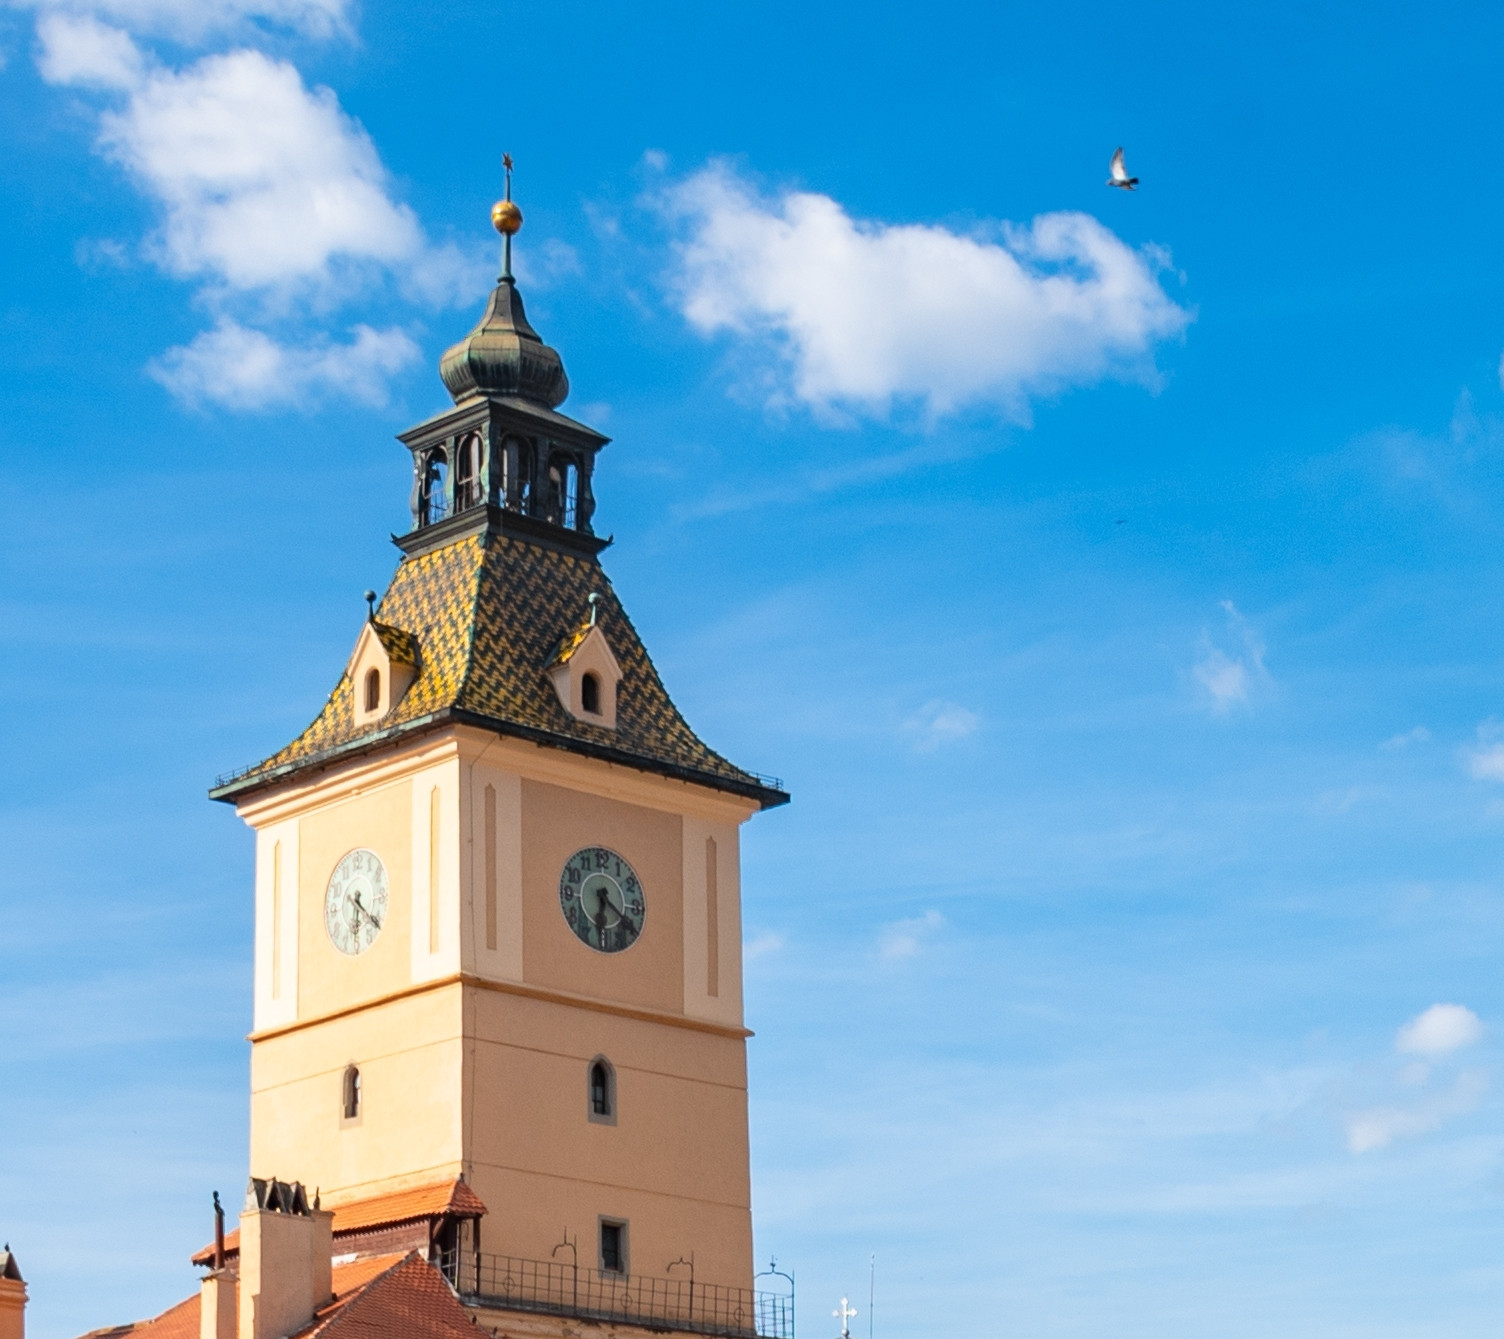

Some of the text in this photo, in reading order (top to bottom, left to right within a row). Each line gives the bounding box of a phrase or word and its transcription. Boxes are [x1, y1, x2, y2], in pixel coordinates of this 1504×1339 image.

[581, 855, 591, 871] 11
[595, 851, 609, 869] 12
[565, 865, 581, 884] 10
[615, 862, 621, 877] 1
[563, 885, 574, 901] 9
[626, 876, 635, 894] 2
[569, 906, 577, 924] 8
[630, 898, 641, 916] 3
